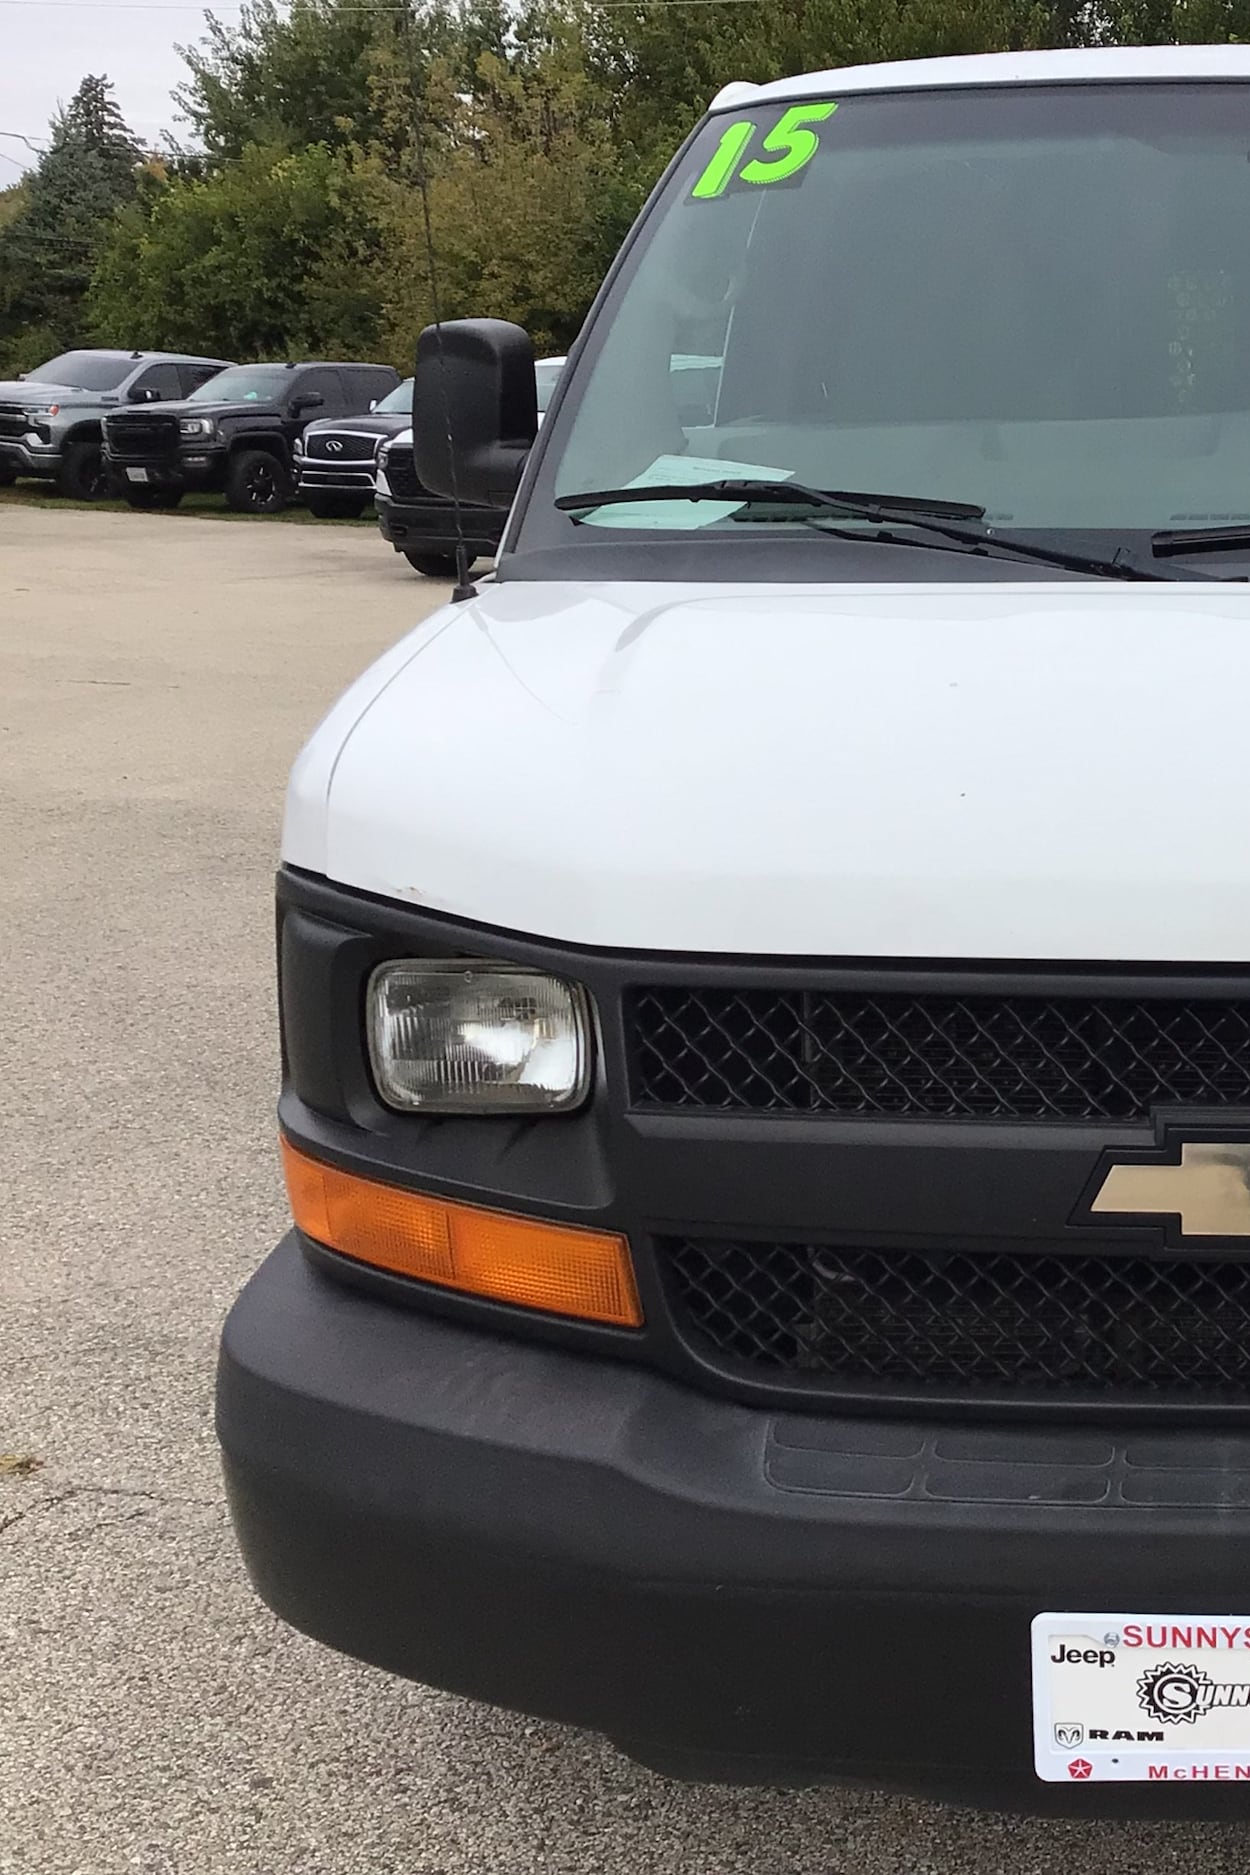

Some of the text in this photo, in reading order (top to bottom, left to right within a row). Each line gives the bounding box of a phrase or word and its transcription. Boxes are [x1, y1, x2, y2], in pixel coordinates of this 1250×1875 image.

[692, 102, 839, 199] 15
[1050, 1644, 1116, 1669] Jeep
[1088, 1729, 1164, 1742] RAM
